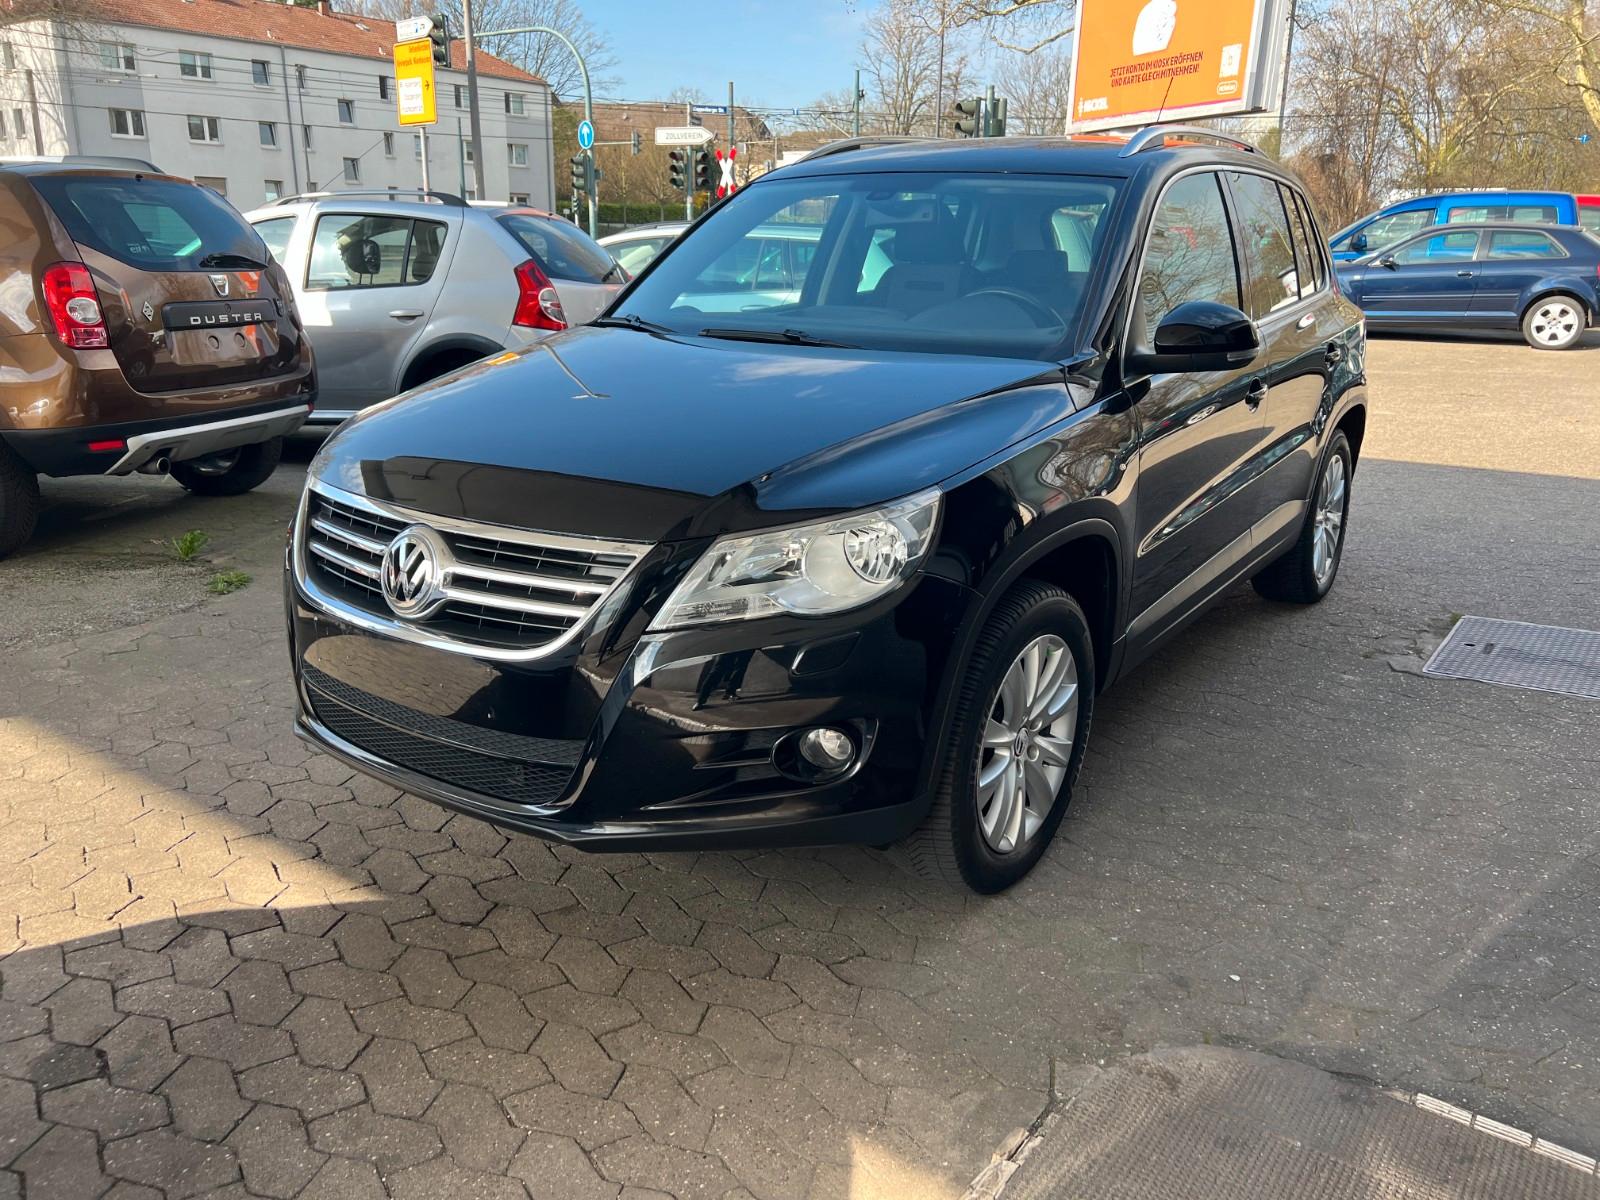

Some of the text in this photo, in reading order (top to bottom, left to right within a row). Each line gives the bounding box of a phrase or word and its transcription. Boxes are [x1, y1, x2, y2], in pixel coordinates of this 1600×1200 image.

[1110, 51, 1204, 78] JETZT KONTO IM KIOSK ERÖFFNEN
[1111, 76, 1123, 88] UND
[1123, 73, 1142, 86] KARTE
[1160, 63, 1200, 79] MITNEHMEN!
[665, 131, 703, 140] ZOLLVEREIN
[190, 312, 262, 325] DUSTER
